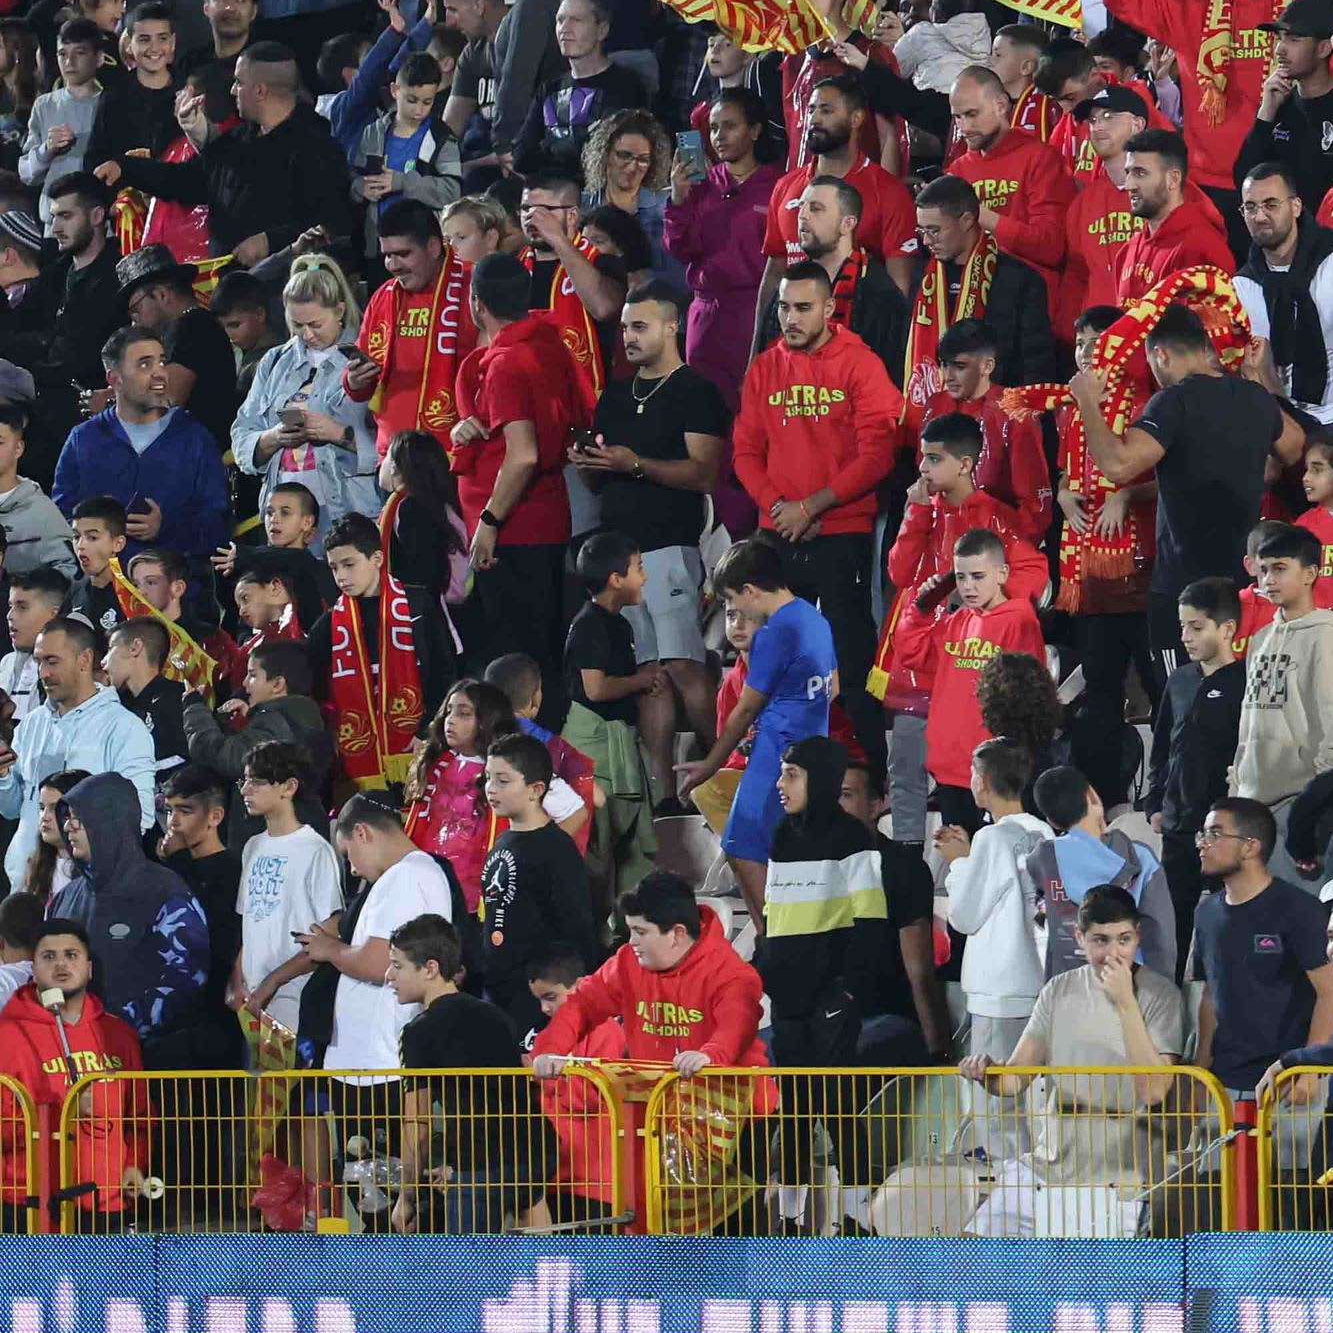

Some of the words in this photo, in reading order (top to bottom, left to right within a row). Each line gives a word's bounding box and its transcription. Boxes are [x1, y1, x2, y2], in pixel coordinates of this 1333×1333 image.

[972, 179, 1020, 199] TRAS
[1088, 211, 1144, 234] ULTRA
[768, 385, 845, 406] ULTRAS
[636, 1000, 705, 1025] ULTRAS
